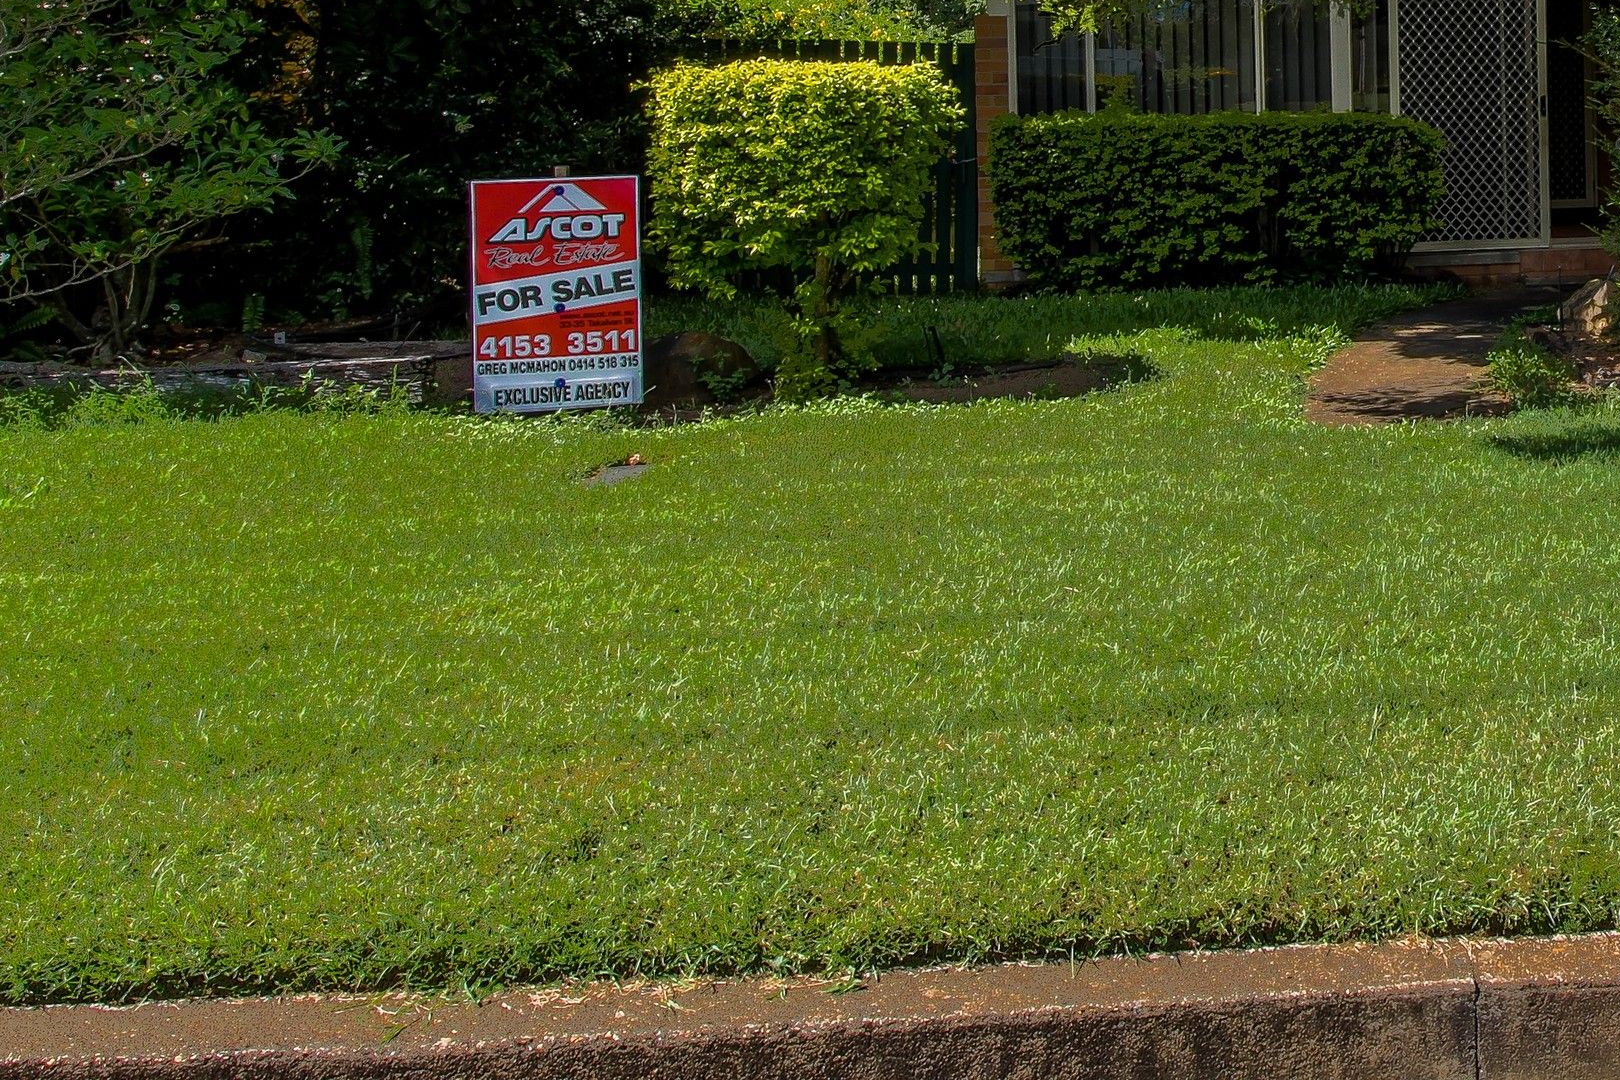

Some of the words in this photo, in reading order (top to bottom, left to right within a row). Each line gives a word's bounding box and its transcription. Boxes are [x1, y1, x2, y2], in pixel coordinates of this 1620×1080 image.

[488, 213, 625, 243] ASCOT
[484, 245, 550, 268] Real
[553, 241, 625, 265] Estate
[477, 285, 543, 316] FOR
[551, 269, 635, 302] SALE
[480, 334, 551, 358] 4153
[567, 329, 636, 353] 3511
[477, 362, 508, 376] GREG
[509, 358, 567, 374] MCMAHON
[568, 358, 596, 371] 0414
[598, 356, 617, 369] 518
[619, 354, 640, 367] 315
[494, 386, 571, 406] EXCLUSIVE
[574, 381, 630, 401] AGENCY
